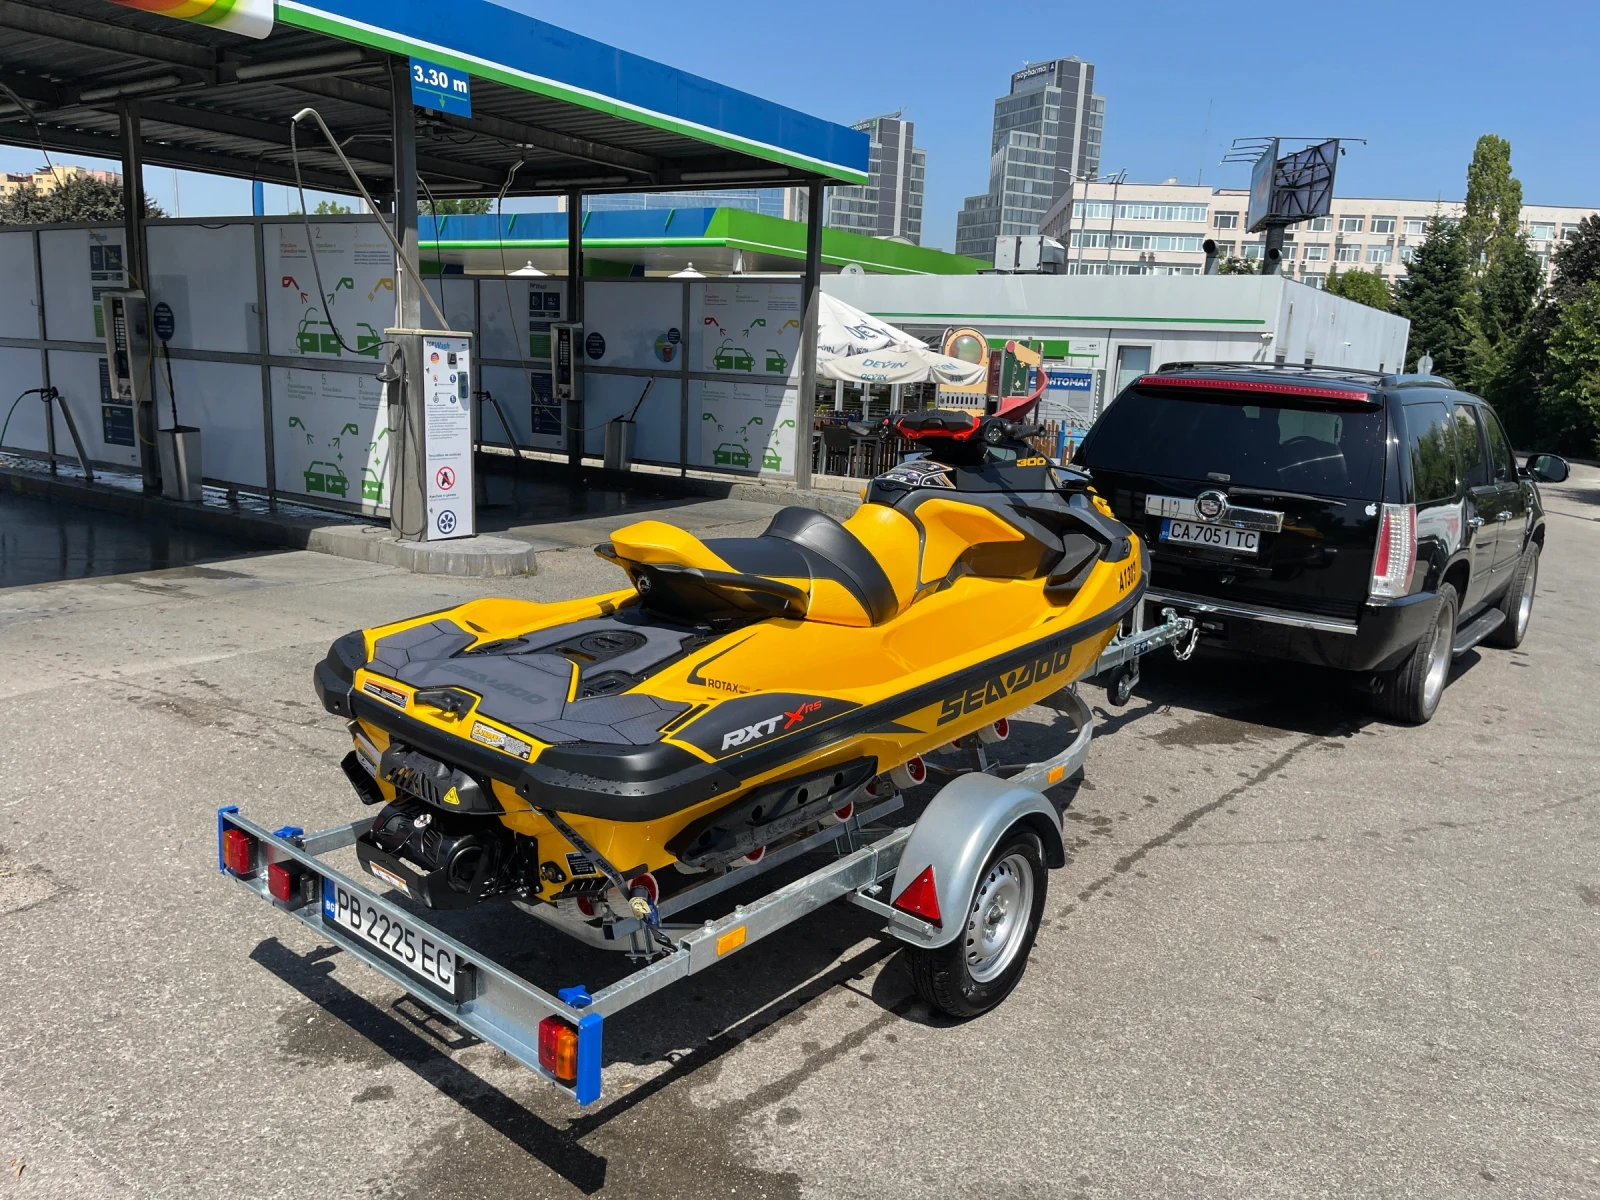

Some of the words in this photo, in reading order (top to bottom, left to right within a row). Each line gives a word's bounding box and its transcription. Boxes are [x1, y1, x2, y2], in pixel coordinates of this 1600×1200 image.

[1016, 65, 1047, 80] sopharma
[1050, 62, 1055, 71] A
[413, 65, 448, 88] 3.30
[453, 79, 468, 94] m
[862, 358, 909, 369] DEVIN
[1029, 376, 1091, 387] ЕНТОМАТ
[1016, 457, 1047, 467] 300
[1171, 523, 1190, 540] CA
[1193, 525, 1231, 547] 7051
[1235, 530, 1257, 549] TC
[708, 678, 739, 693] ROTAX
[721, 714, 784, 751] RXT
[325, 899, 336, 912] BG
[337, 887, 362, 930] PB
[366, 907, 417, 964] 2225
[421, 938, 452, 985] EC
